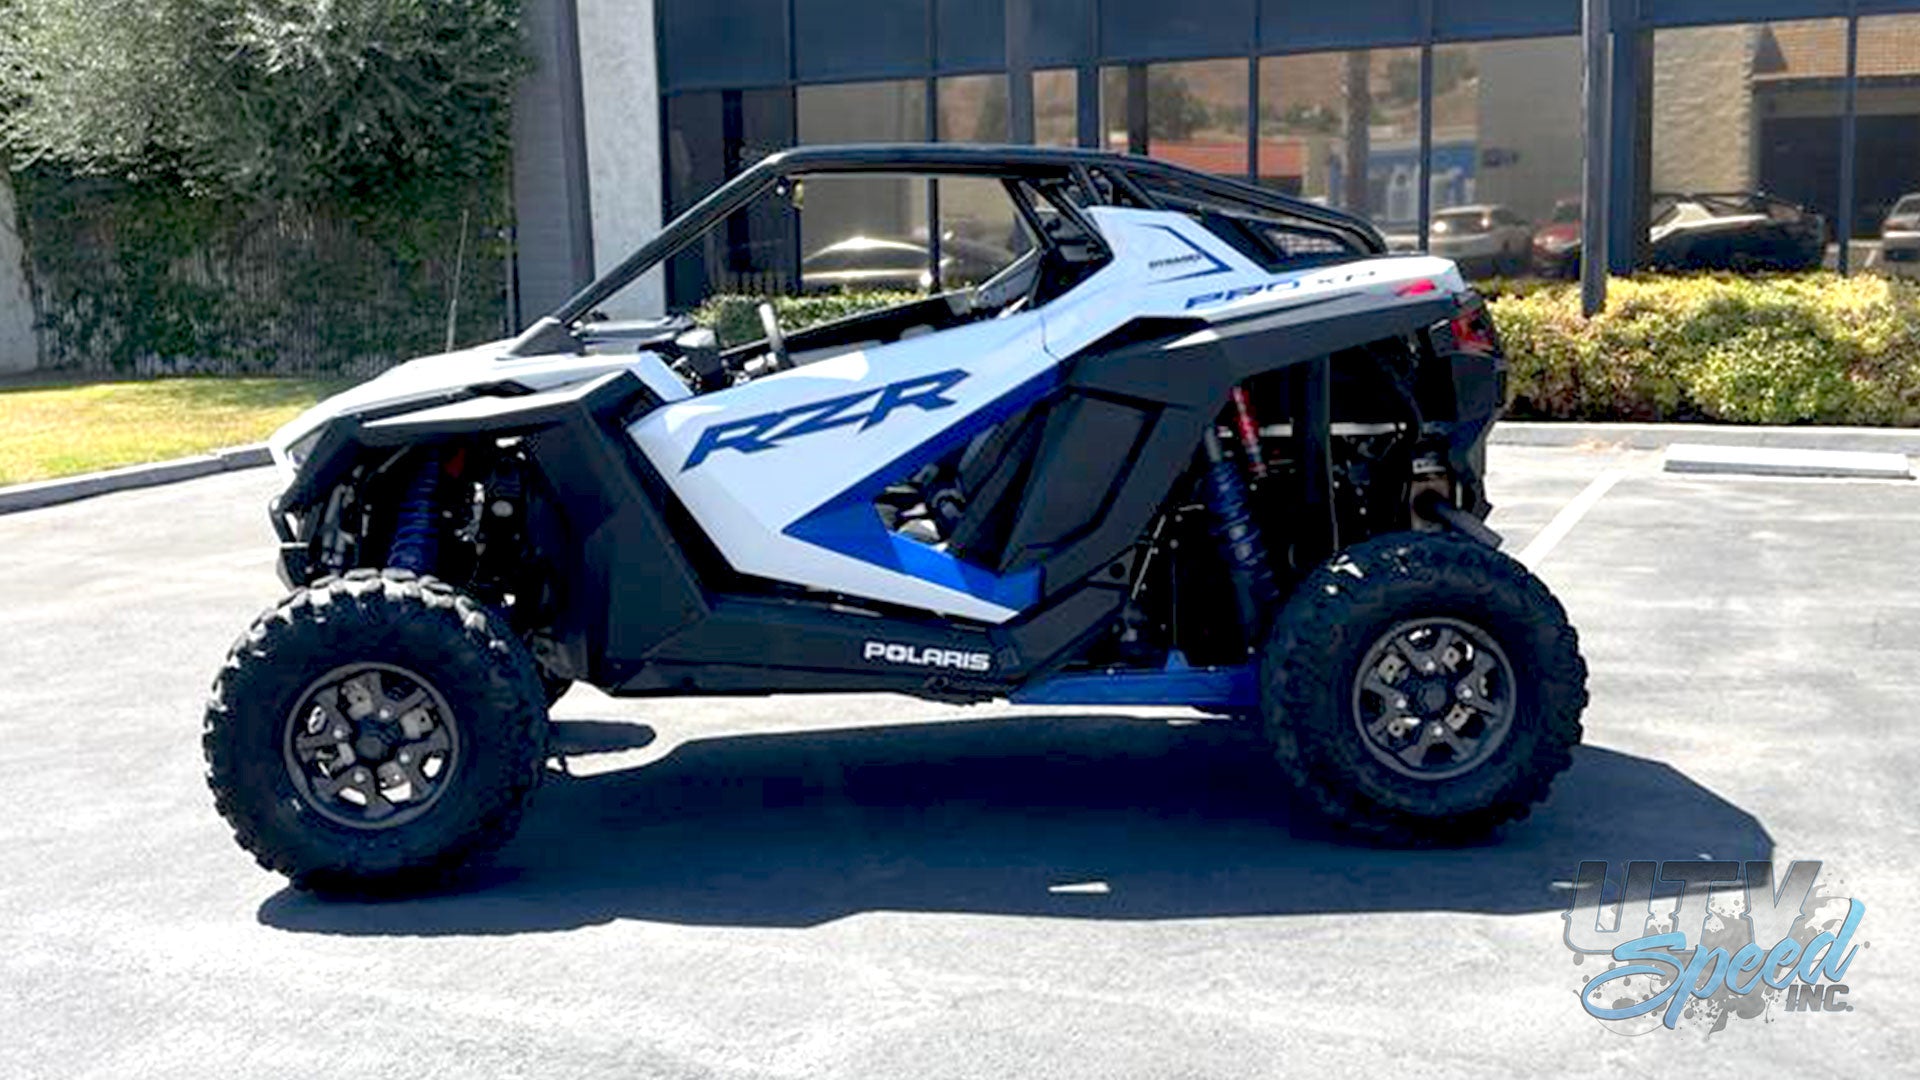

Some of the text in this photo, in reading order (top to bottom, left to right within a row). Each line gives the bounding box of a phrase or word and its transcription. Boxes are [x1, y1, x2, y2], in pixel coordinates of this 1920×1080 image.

[1185, 278, 1300, 310] PRO
[680, 368, 972, 473] RZR
[863, 641, 990, 671] POLARIS
